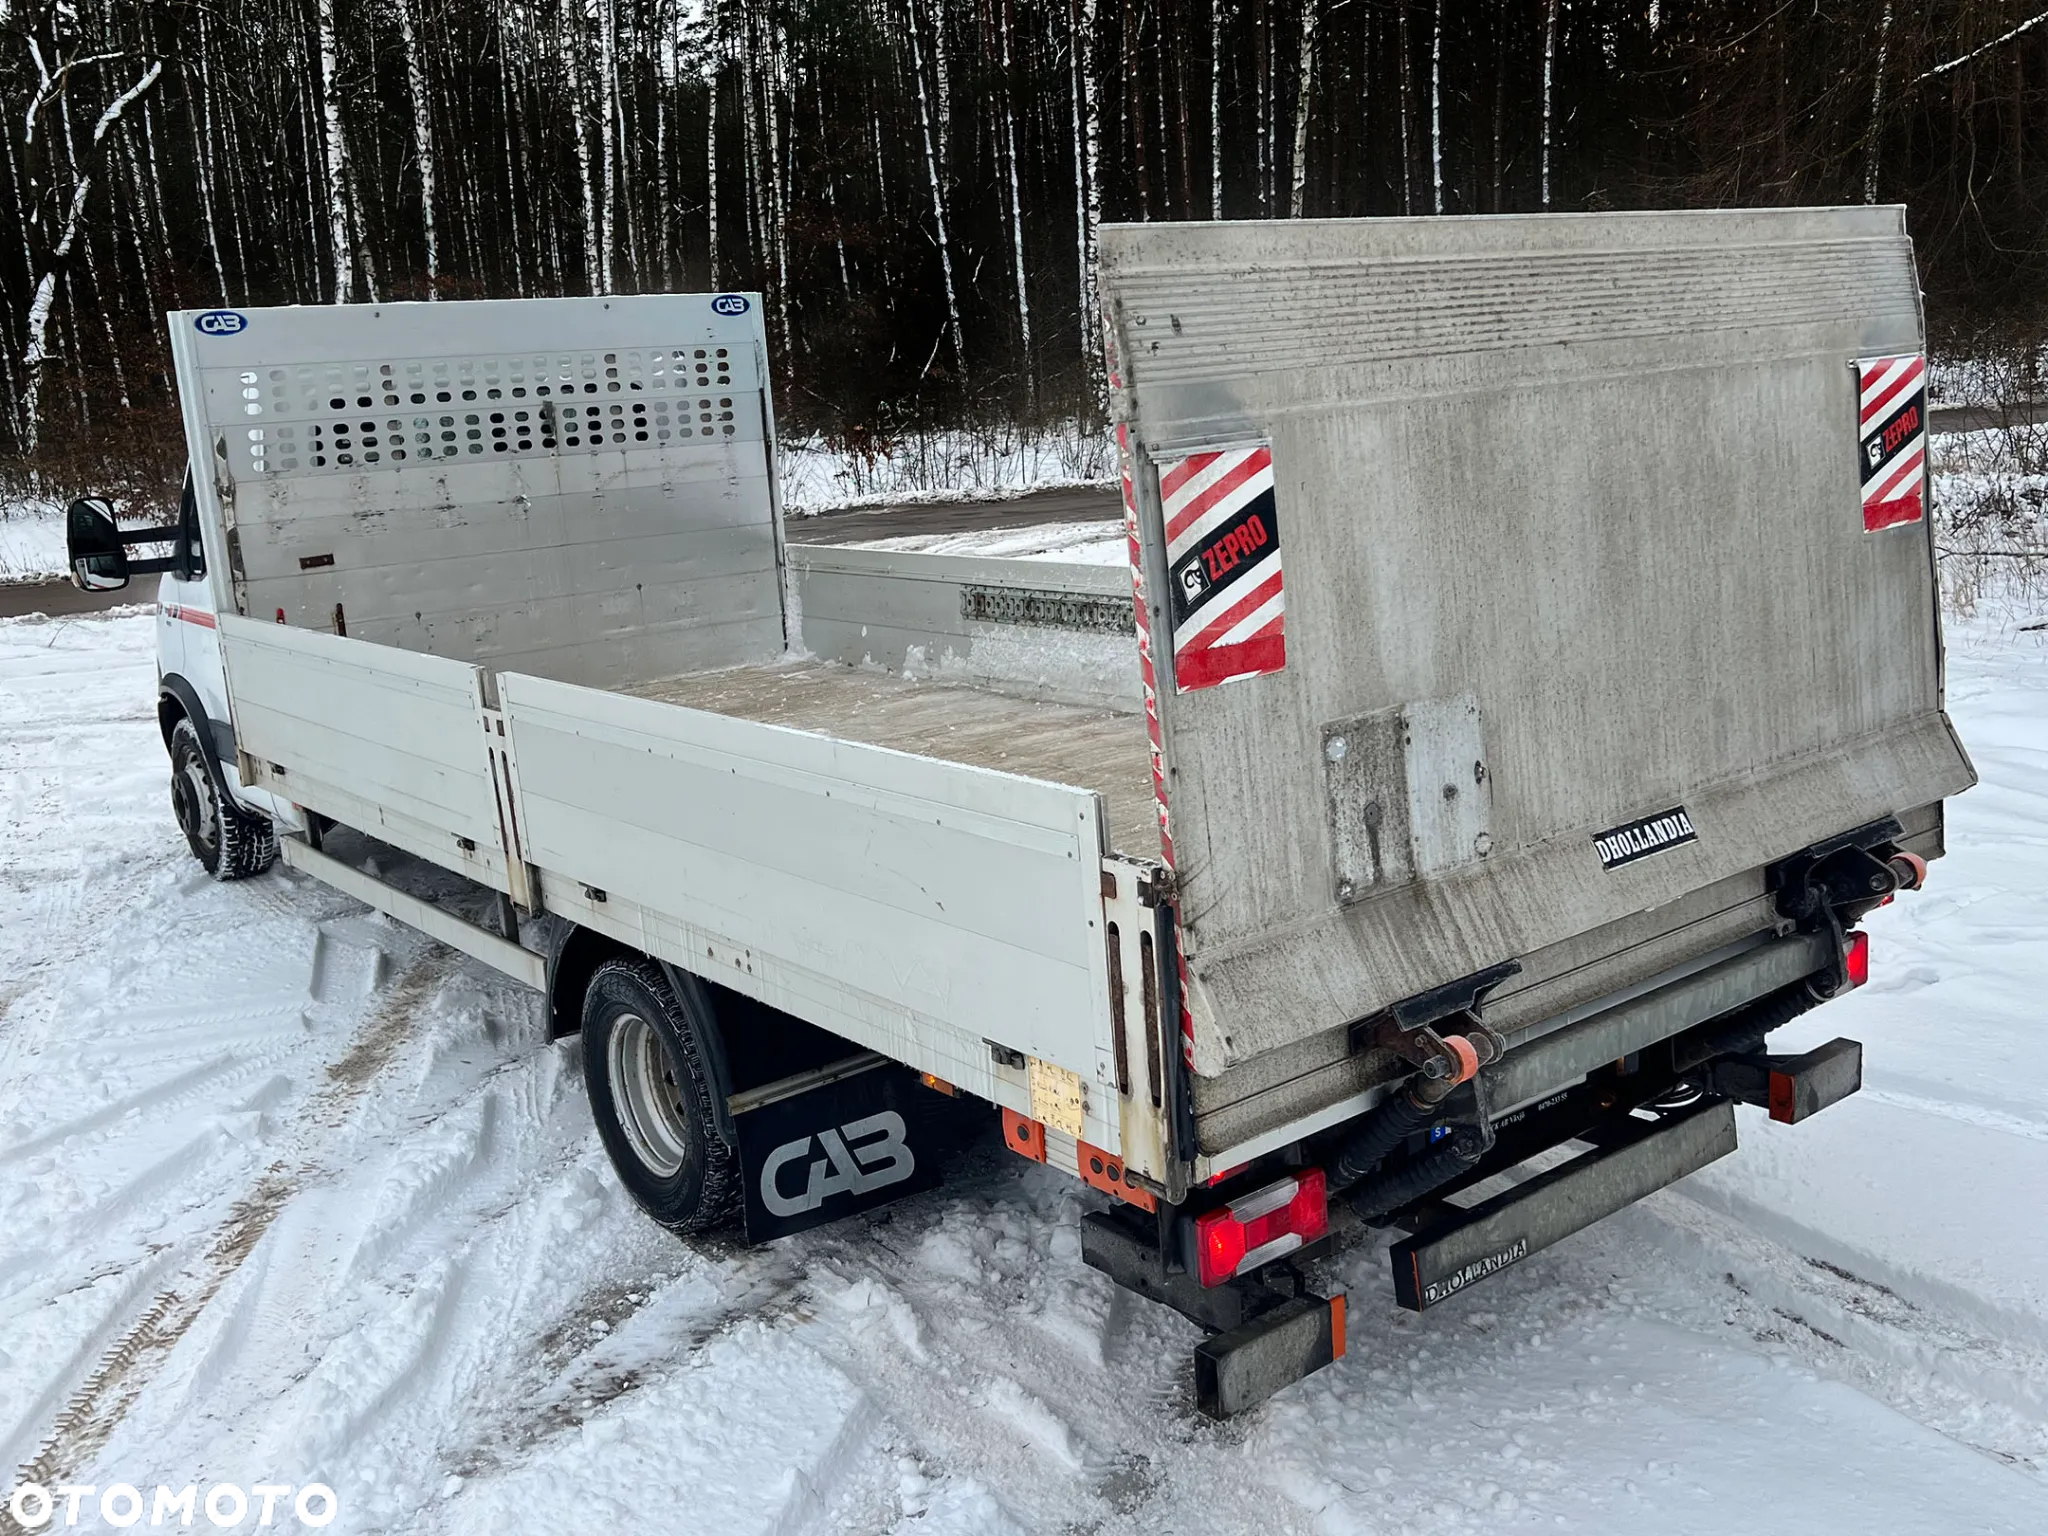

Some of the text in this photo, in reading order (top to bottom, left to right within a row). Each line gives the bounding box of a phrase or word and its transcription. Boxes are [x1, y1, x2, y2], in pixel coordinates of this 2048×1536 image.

[201, 315, 240, 332] CAB
[716, 298, 744, 312] CAB
[1882, 406, 1919, 453] ZEPRO
[1201, 514, 1268, 581] ZEPRO
[1595, 813, 1694, 863] DHOLLANDIA
[1435, 1127, 1441, 1137] S
[760, 1110, 915, 1217] CAB
